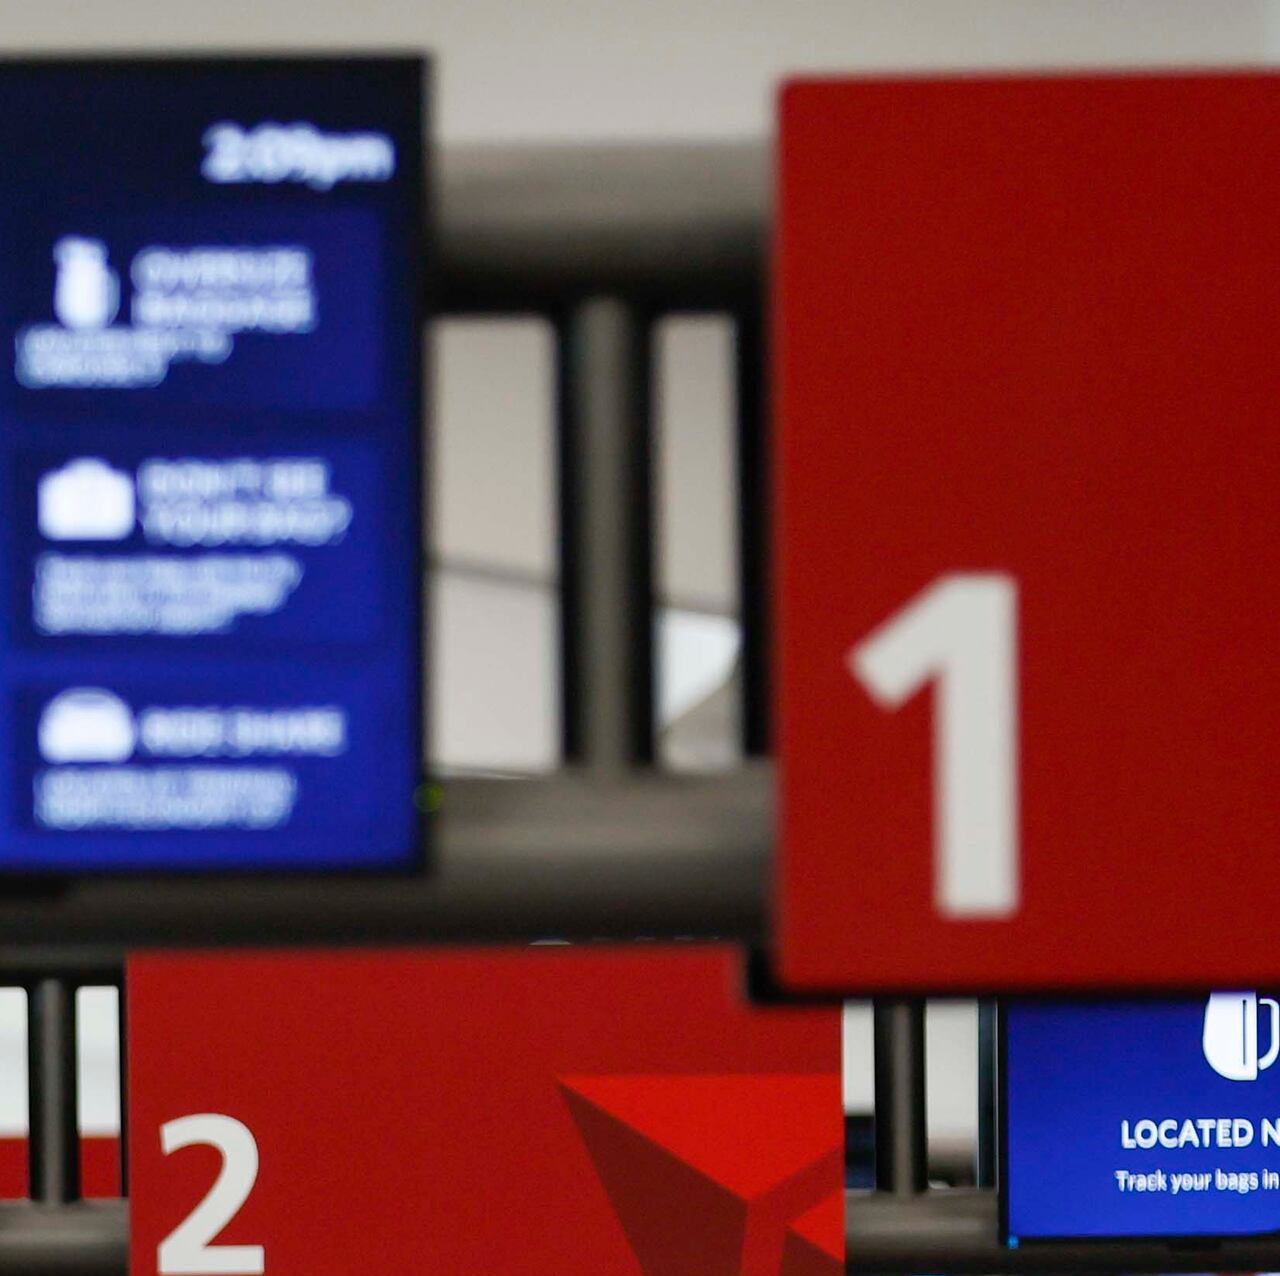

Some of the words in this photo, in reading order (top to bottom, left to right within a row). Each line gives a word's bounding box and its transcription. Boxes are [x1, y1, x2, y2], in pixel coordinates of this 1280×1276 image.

[846, 572, 1021, 919] 1
[1115, 1169, 1169, 1192] Track
[1170, 1172, 1212, 1195] your
[1215, 1168, 1259, 1195] bags
[1261, 1168, 1279, 1191] in
[1121, 1118, 1254, 1149] LOCATED
[156, 1112, 265, 1276] 2
